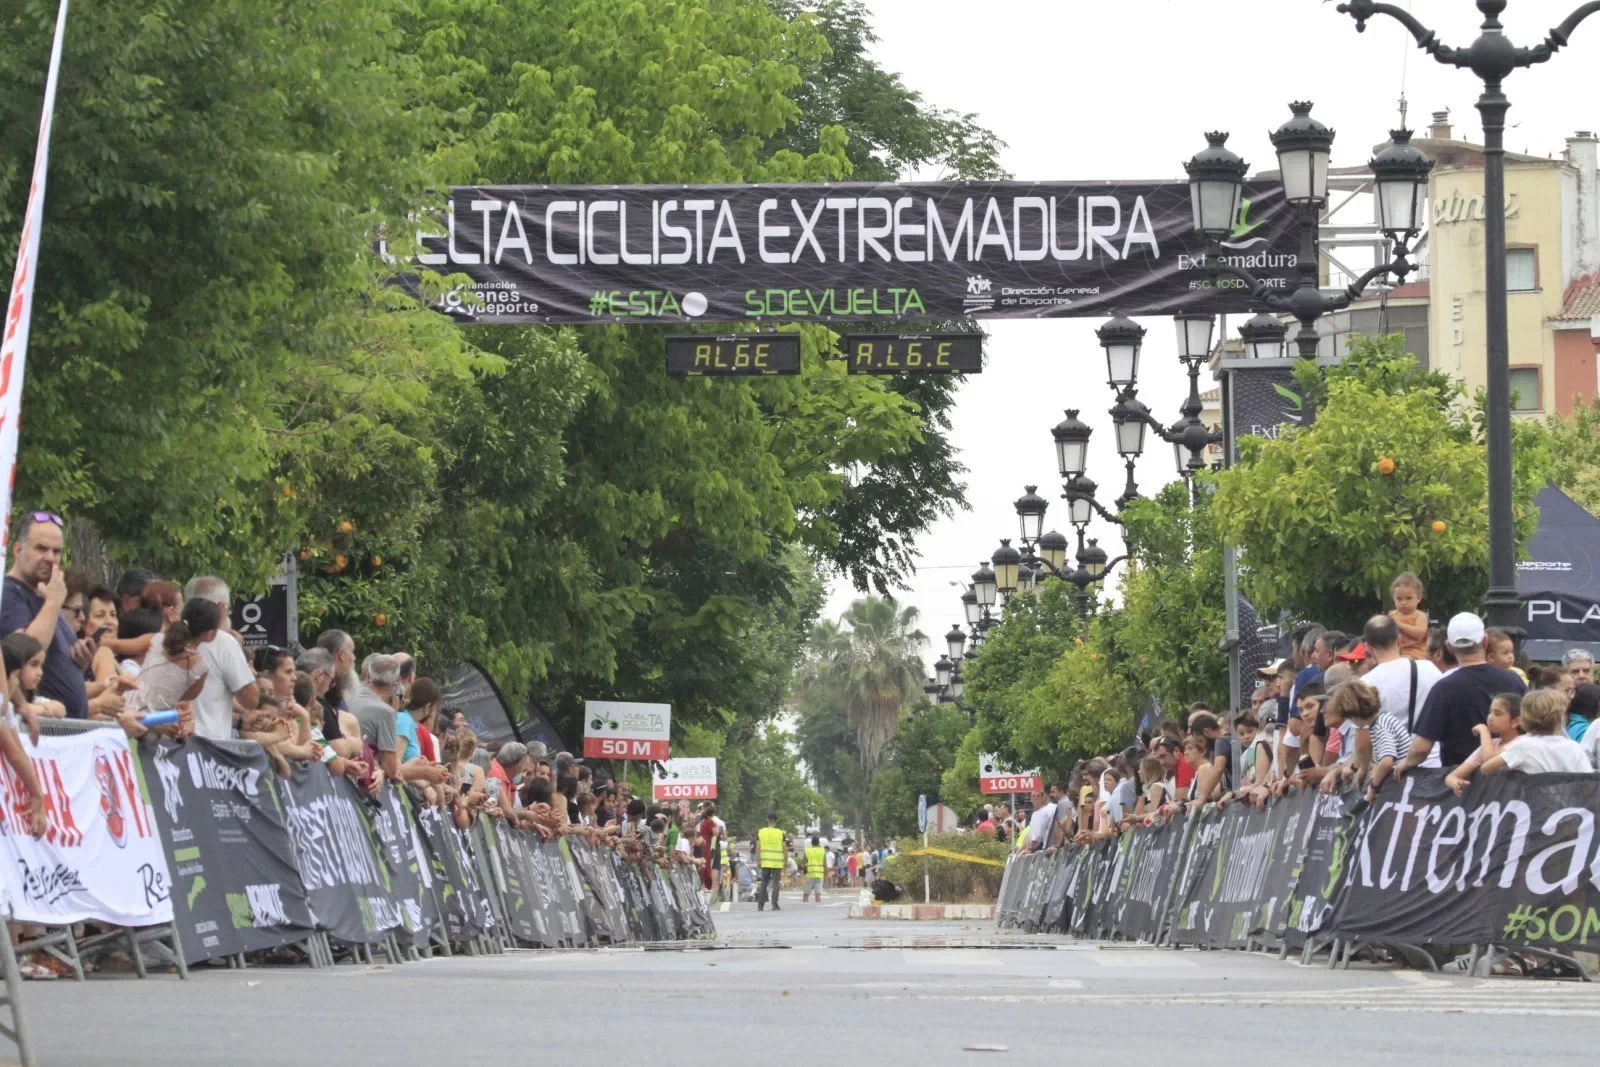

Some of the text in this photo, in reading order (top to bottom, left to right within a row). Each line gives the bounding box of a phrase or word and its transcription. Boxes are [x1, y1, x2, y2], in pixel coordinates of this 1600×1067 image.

[546, 199, 746, 265] CICLISTA
[758, 196, 1160, 264] EXTREMADURA
[1177, 250, 1298, 270] Extemadura
[1001, 286, 1100, 296] Dirección General
[1001, 297, 1017, 305] de
[1019, 297, 1072, 306] Deportes
[602, 740, 651, 756] 50 M
[990, 777, 1034, 790] 100 M
[663, 785, 709, 797] 100 M
